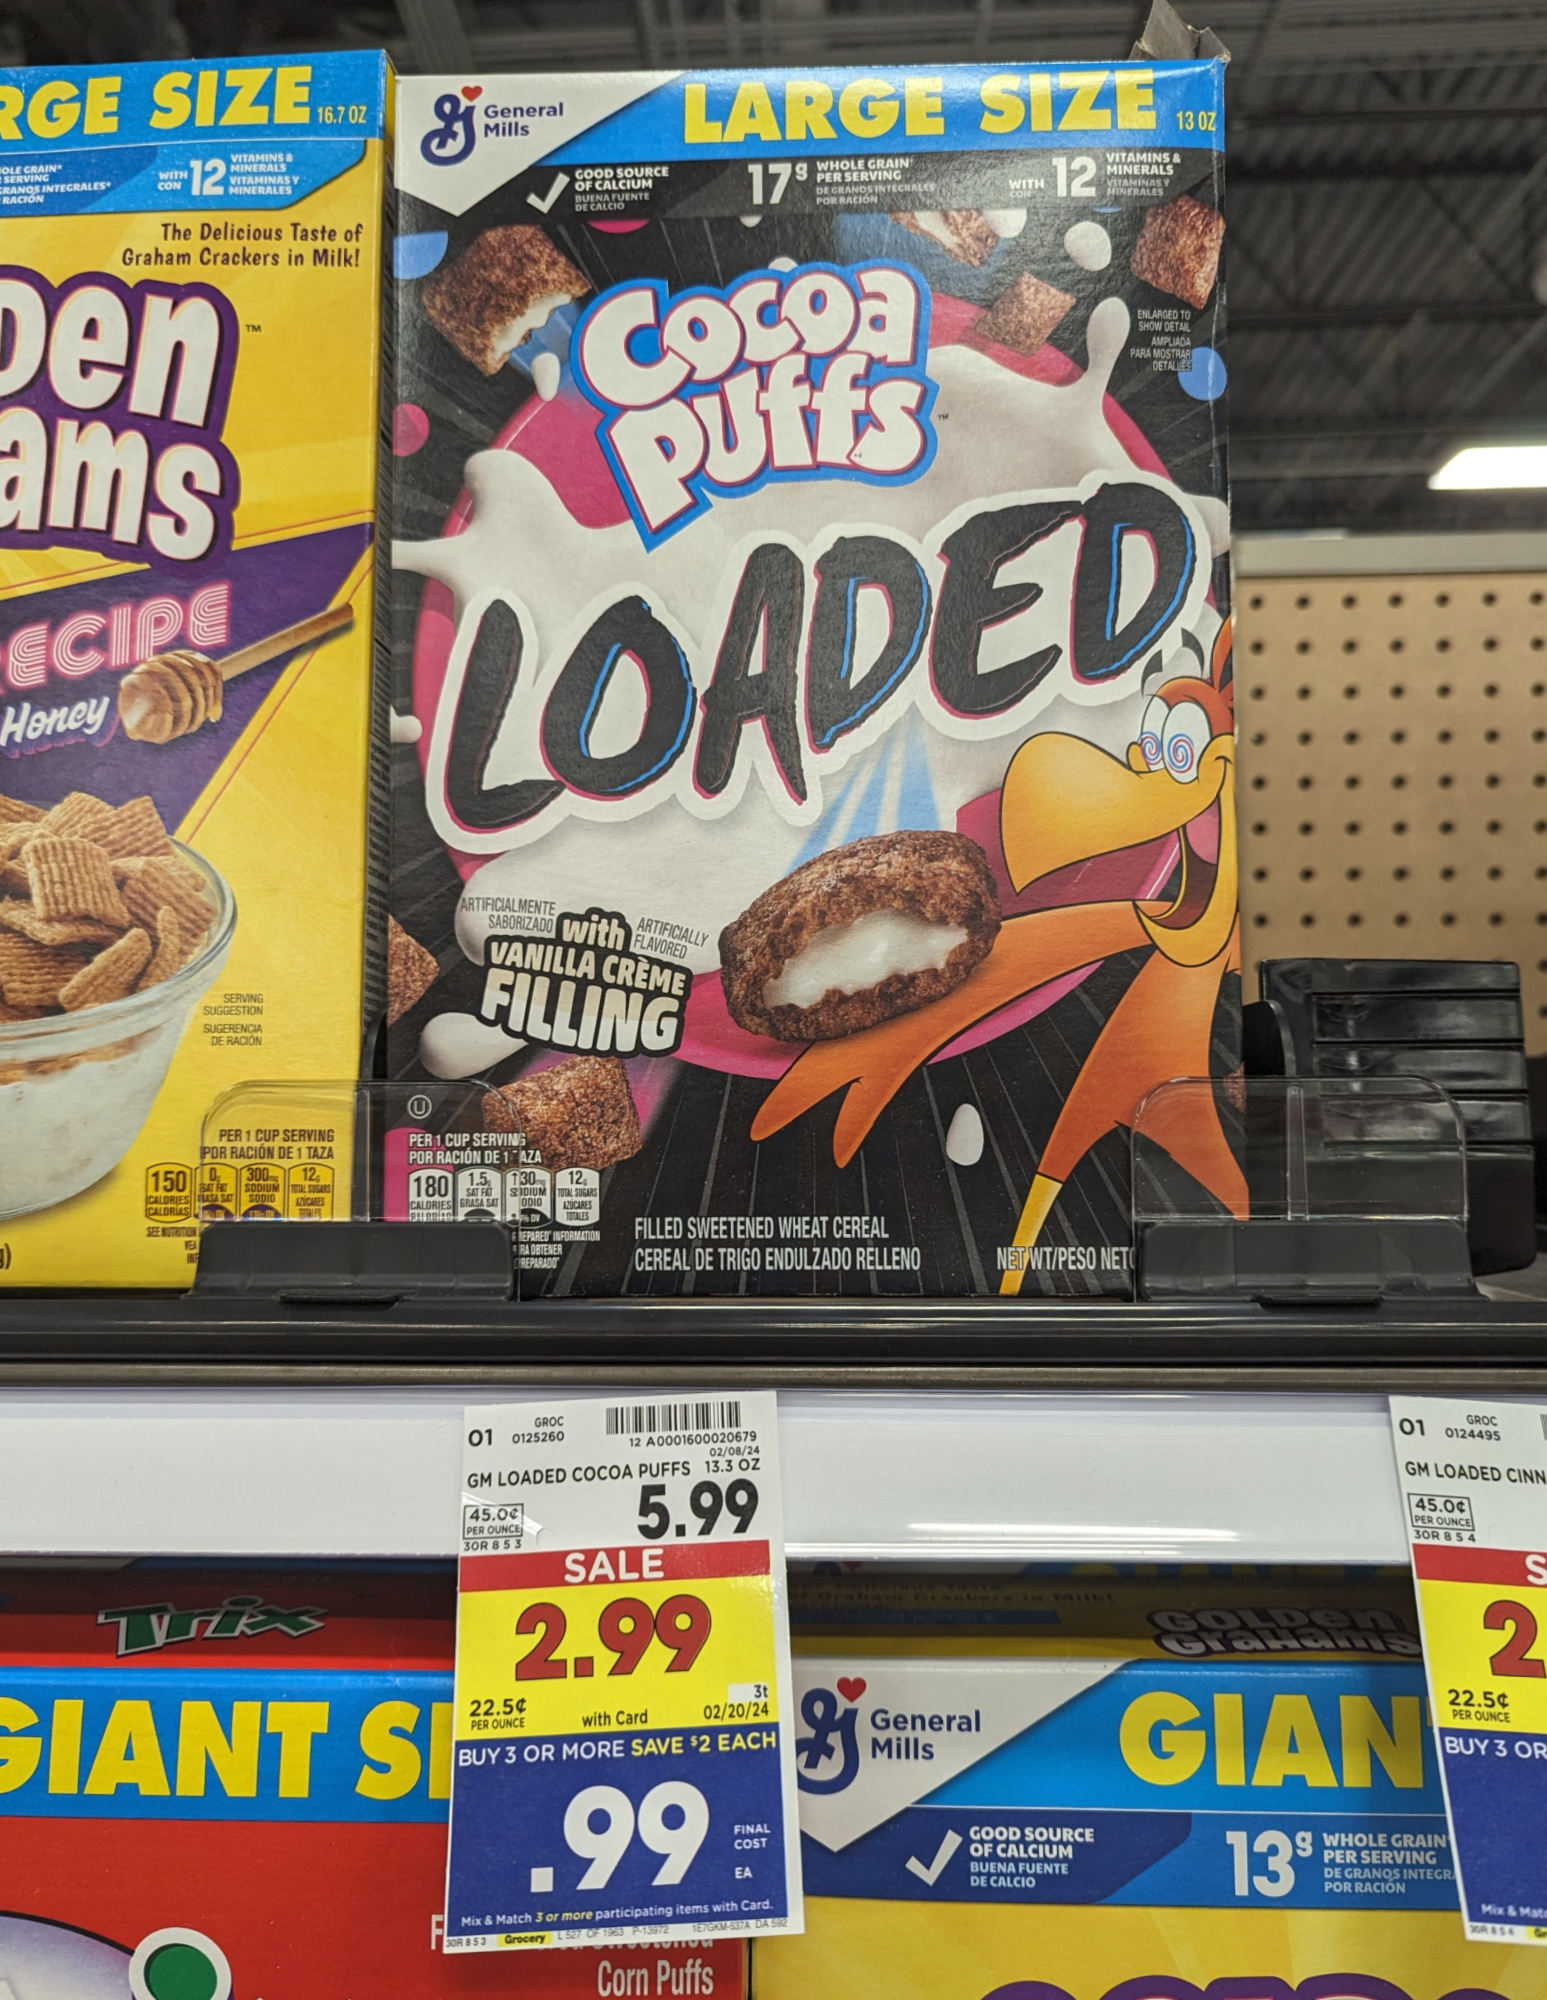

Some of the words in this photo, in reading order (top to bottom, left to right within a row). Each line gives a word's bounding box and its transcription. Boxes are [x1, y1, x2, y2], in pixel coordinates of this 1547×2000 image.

[149, 66, 312, 129] SIZE
[317, 107, 345, 124] 16.7
[348, 105, 367, 123] OZ
[484, 102, 564, 119] General
[684, 77, 944, 144] LARGE
[980, 69, 1156, 134] SIZE
[1176, 111, 1195, 131] 13
[1198, 111, 1216, 132] OZ
[484, 122, 530, 137] Mills
[230, 163, 287, 173] MINERALS
[575, 169, 614, 180] GOOD
[616, 167, 670, 179] SOURCE
[816, 160, 865, 171] WHOLE
[1106, 164, 1174, 175] MINERALS
[157, 181, 182, 191] CON
[229, 175, 290, 185] VITAMINAS
[158, 171, 188, 181] WITH
[190, 159, 226, 196] 12
[230, 153, 283, 163] VITAMINS
[816, 171, 842, 183] PER
[844, 169, 902, 182] SERVING
[1009, 179, 1045, 190] WITH
[1052, 156, 1097, 197] 12
[1106, 153, 1170, 164] VITAMINS
[229, 185, 292, 196] MINERALES
[575, 180, 592, 192] OF
[595, 178, 653, 191] CALCIUM
[575, 193, 605, 203] BUENA
[607, 192, 650, 202] FUENTE
[575, 203, 587, 212] DE
[589, 202, 625, 212] CALCIO
[161, 223, 192, 241] The
[200, 223, 283, 241] Delicious
[290, 223, 337, 242] Taste
[344, 223, 363, 242] of
[122, 248, 191, 266] Graham
[199, 248, 280, 266] Crackers
[287, 248, 304, 266] in
[313, 248, 360, 267] Milk!
[1137, 310, 1178, 320] ENLARGED
[1180, 311, 1191, 320] TO
[1138, 321, 1162, 332] SHOW
[1164, 322, 1191, 332] DETAIL
[447, 481, 1197, 834] LOADED
[460, 897, 557, 916] ARTIFICIALMENTE
[488, 914, 554, 933] SABORIZADO
[562, 914, 625, 950] with
[636, 917, 709, 948] ARTIFICIALLY
[634, 934, 688, 959] FLAVORED
[491, 941, 596, 980] VANILLA
[602, 955, 686, 996] CRÈME
[224, 993, 264, 1004] SERVING
[203, 1005, 263, 1016] SUGGESTION
[480, 967, 680, 1052] FILLING
[203, 1023, 263, 1035] SUGERENCIA
[211, 1036, 225, 1046] DE
[226, 1034, 263, 1047] RACIÓN
[219, 1129, 242, 1142] PER
[255, 1129, 279, 1142] CUP
[282, 1129, 335, 1143] SERVING
[409, 1133, 432, 1147] PER
[445, 1133, 470, 1147] CUP
[230, 1143, 275, 1159] RACIÓN
[278, 1147, 294, 1159] DE
[307, 1147, 334, 1159] TAZA
[409, 1151, 433, 1164] POR
[436, 1148, 481, 1164] RACIÓN
[484, 1150, 500, 1164] DE
[151, 1171, 187, 1192] 150
[413, 1175, 449, 1198] 180
[635, 1217, 683, 1240] FILLED
[687, 1217, 774, 1240] SWEETENED
[778, 1217, 829, 1240] WHEAT
[833, 1216, 889, 1239] CEREAL
[634, 1248, 691, 1272] CEREAL
[695, 1248, 714, 1272] DE
[717, 1248, 761, 1272] TRIGO
[765, 1248, 852, 1272] ENDULZADO
[855, 1247, 921, 1271] RELLENO
[997, 1247, 1025, 1270] NET
[1029, 1247, 1096, 1271] WT/PESO
[534, 1416, 564, 1428] GROC
[1467, 1414, 1498, 1426] GROC
[512, 1430, 565, 1444] 0125260
[1445, 1427, 1501, 1441] 0124495
[709, 1445, 760, 1458] 02/08/24
[467, 1471, 492, 1489] GM
[498, 1467, 567, 1487] LOADED
[572, 1464, 634, 1482] COCOA
[638, 1461, 691, 1479] PUFFS
[704, 1459, 733, 1474] 13.3
[739, 1457, 761, 1472] OZ
[1405, 1461, 1430, 1477] GM
[1434, 1463, 1501, 1481] LOADED
[637, 1478, 759, 1540] 5.99
[1415, 1497, 1466, 1514] 45.0¢
[470, 1507, 519, 1523] 45.0¢
[467, 1526, 485, 1536] PER
[487, 1524, 521, 1535] OUNCE
[564, 1548, 664, 1584] SALE
[97, 1595, 328, 1657] Trix
[515, 1594, 712, 1681] 2.99
[754, 1684, 768, 1698] 3t
[1448, 1689, 1509, 1709] 22.5¢
[470, 1698, 527, 1718] 22.5¢
[582, 1712, 611, 1728] with
[616, 1709, 648, 1726] Card
[704, 1701, 769, 1720] 02/20/24
[471, 1719, 489, 1730] PER
[492, 1717, 525, 1729] OUNCE
[870, 1708, 981, 1732] General
[459, 1747, 500, 1766] BUY
[504, 1746, 516, 1763] 3
[524, 1744, 554, 1762] OR
[562, 1739, 625, 1760] MORE
[631, 1736, 684, 1757] SAVE
[690, 1735, 710, 1753] $2
[718, 1731, 776, 1752] EACH
[871, 1737, 934, 1760] Mills
[1444, 1737, 1489, 1755] BUY
[530, 1780, 710, 1893] .99
[734, 1823, 770, 1835] FINAL
[969, 1826, 1019, 1843] GOOD
[1024, 1827, 1095, 1844] SOURCE
[734, 1838, 767, 1850] COST
[1323, 1833, 1387, 1848] WHOLE
[970, 1842, 992, 1858] OF
[997, 1843, 1073, 1859] CALCIUM
[1323, 1850, 1354, 1864] PER
[1358, 1850, 1436, 1865] SERVING
[735, 1867, 753, 1879] EA
[970, 1861, 1014, 1875] BUENA
[1018, 1862, 1068, 1876] FUENTE
[970, 1875, 988, 1887] DE
[991, 1876, 1035, 1888] CALCIO
[461, 1915, 482, 1927] Mix
[496, 1912, 532, 1925] Match
[535, 1912, 543, 1923] 3
[545, 1912, 560, 1923] or
[561, 1910, 593, 1922] more
[595, 1904, 673, 1921] participating
[676, 1901, 710, 1915] items
[712, 1900, 738, 1912] with
[741, 1899, 774, 1911] Card.
[505, 1934, 546, 1946] Grocery
[598, 1959, 648, 1997] Corn
[657, 1958, 714, 1995] Puffs
